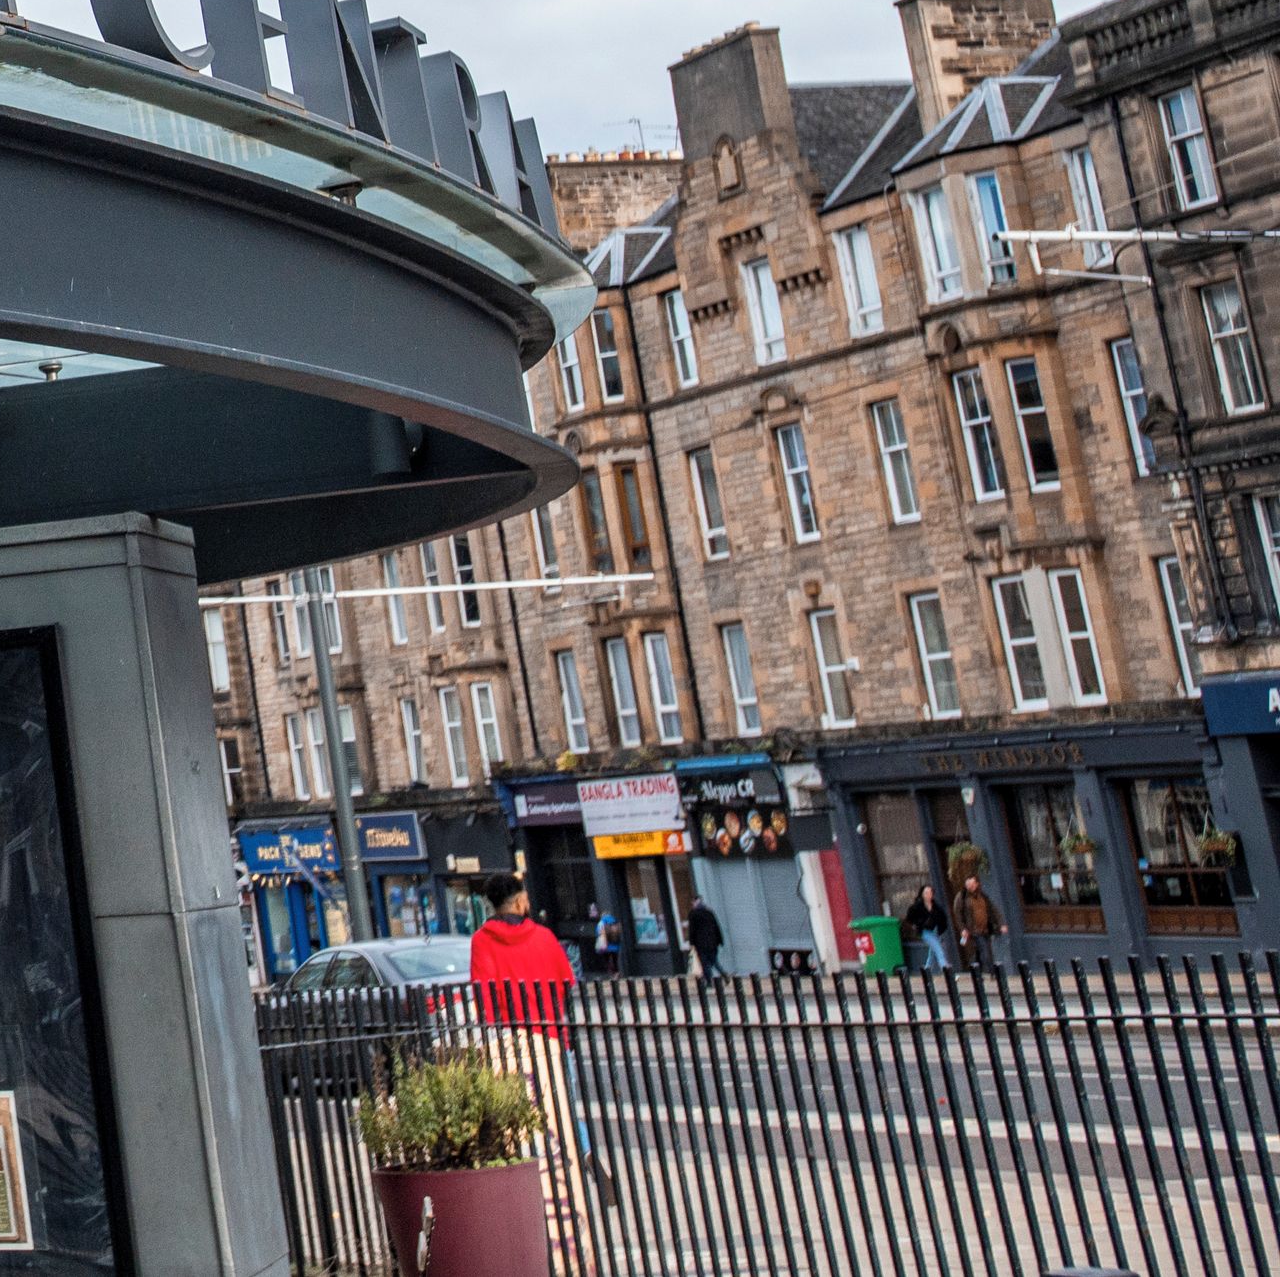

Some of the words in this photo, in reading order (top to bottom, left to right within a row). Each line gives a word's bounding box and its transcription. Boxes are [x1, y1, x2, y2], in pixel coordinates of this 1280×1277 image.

[976, 741, 1085, 770] WINDSOR
[580, 780, 623, 803] BANGLA
[624, 776, 676, 798] TRADING
